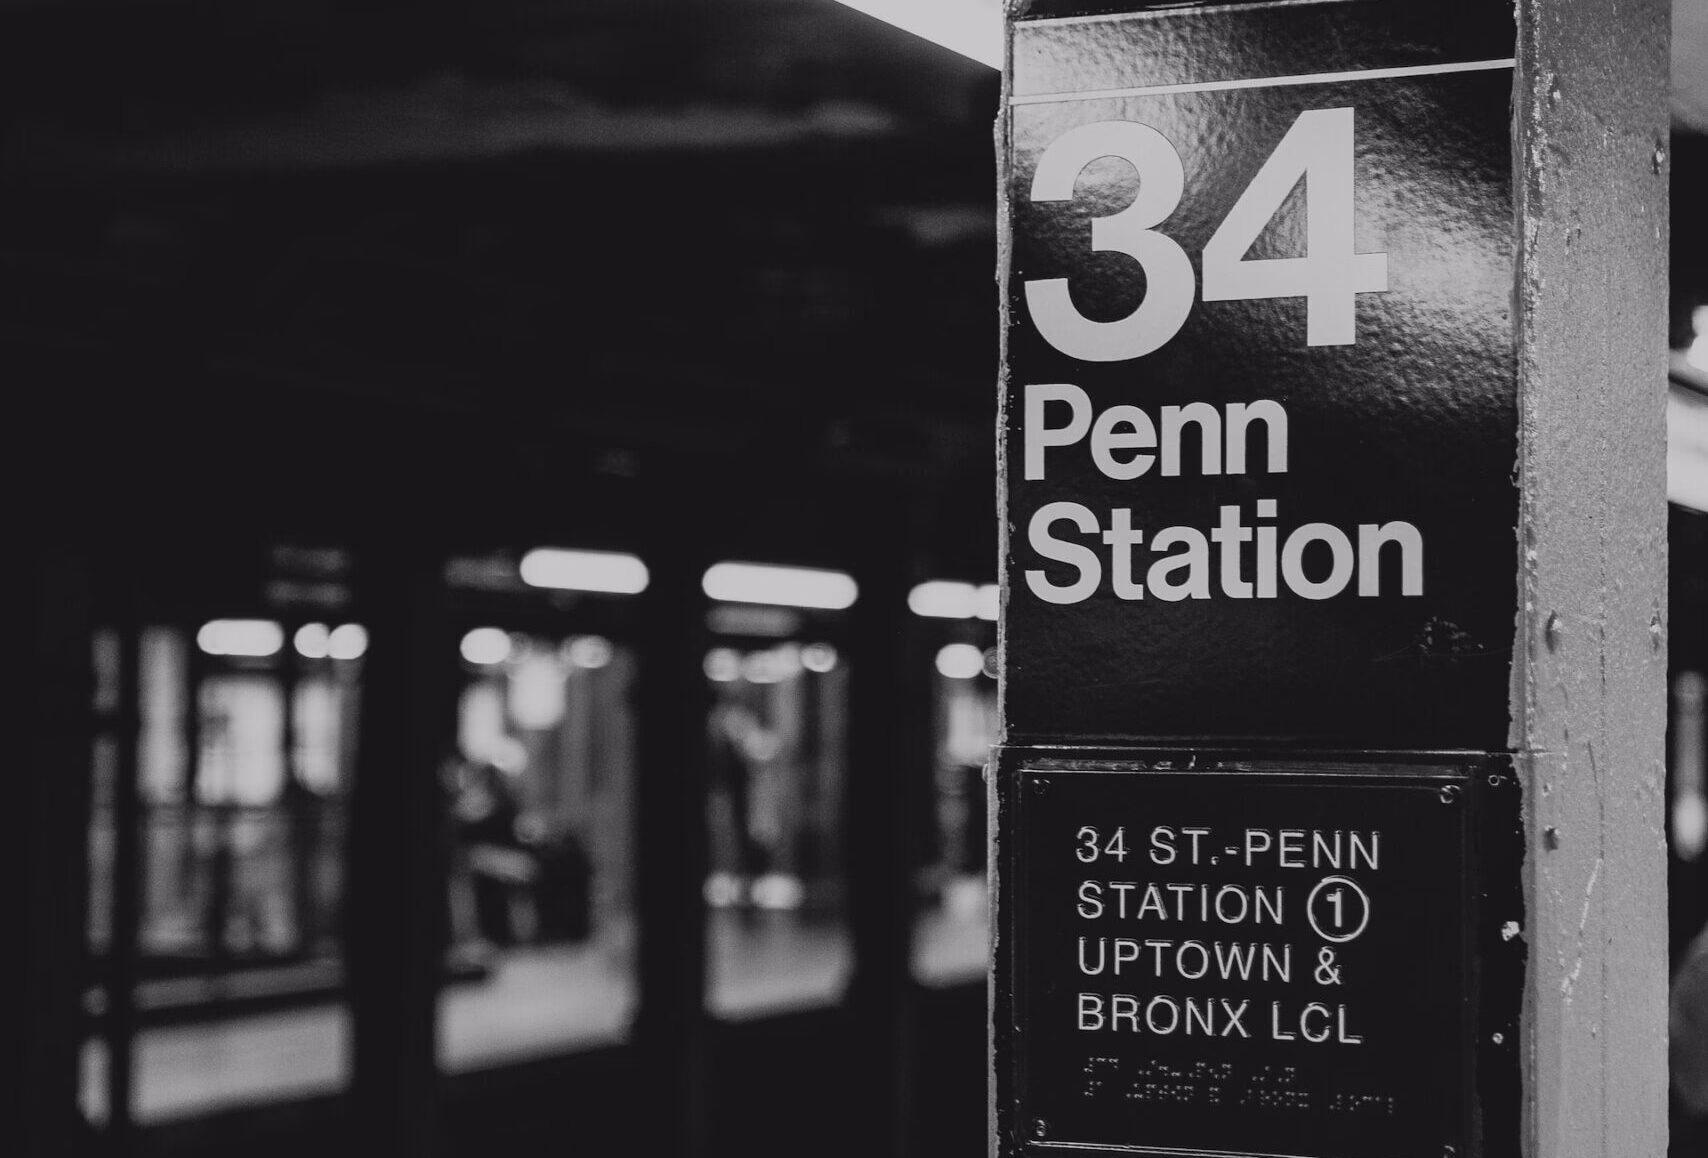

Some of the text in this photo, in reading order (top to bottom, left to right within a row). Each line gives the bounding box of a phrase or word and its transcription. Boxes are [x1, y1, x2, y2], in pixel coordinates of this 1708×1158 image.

[1024, 107, 1388, 362] 34
[1024, 383, 1288, 481] Penn
[1024, 499, 1424, 604] Station
[1076, 825, 1381, 870] 34 ST.-PENN
[1077, 881, 1284, 925] STATION
[1078, 937, 1343, 986] UPTOWN &
[1078, 993, 1364, 1044] BRONX LCL
